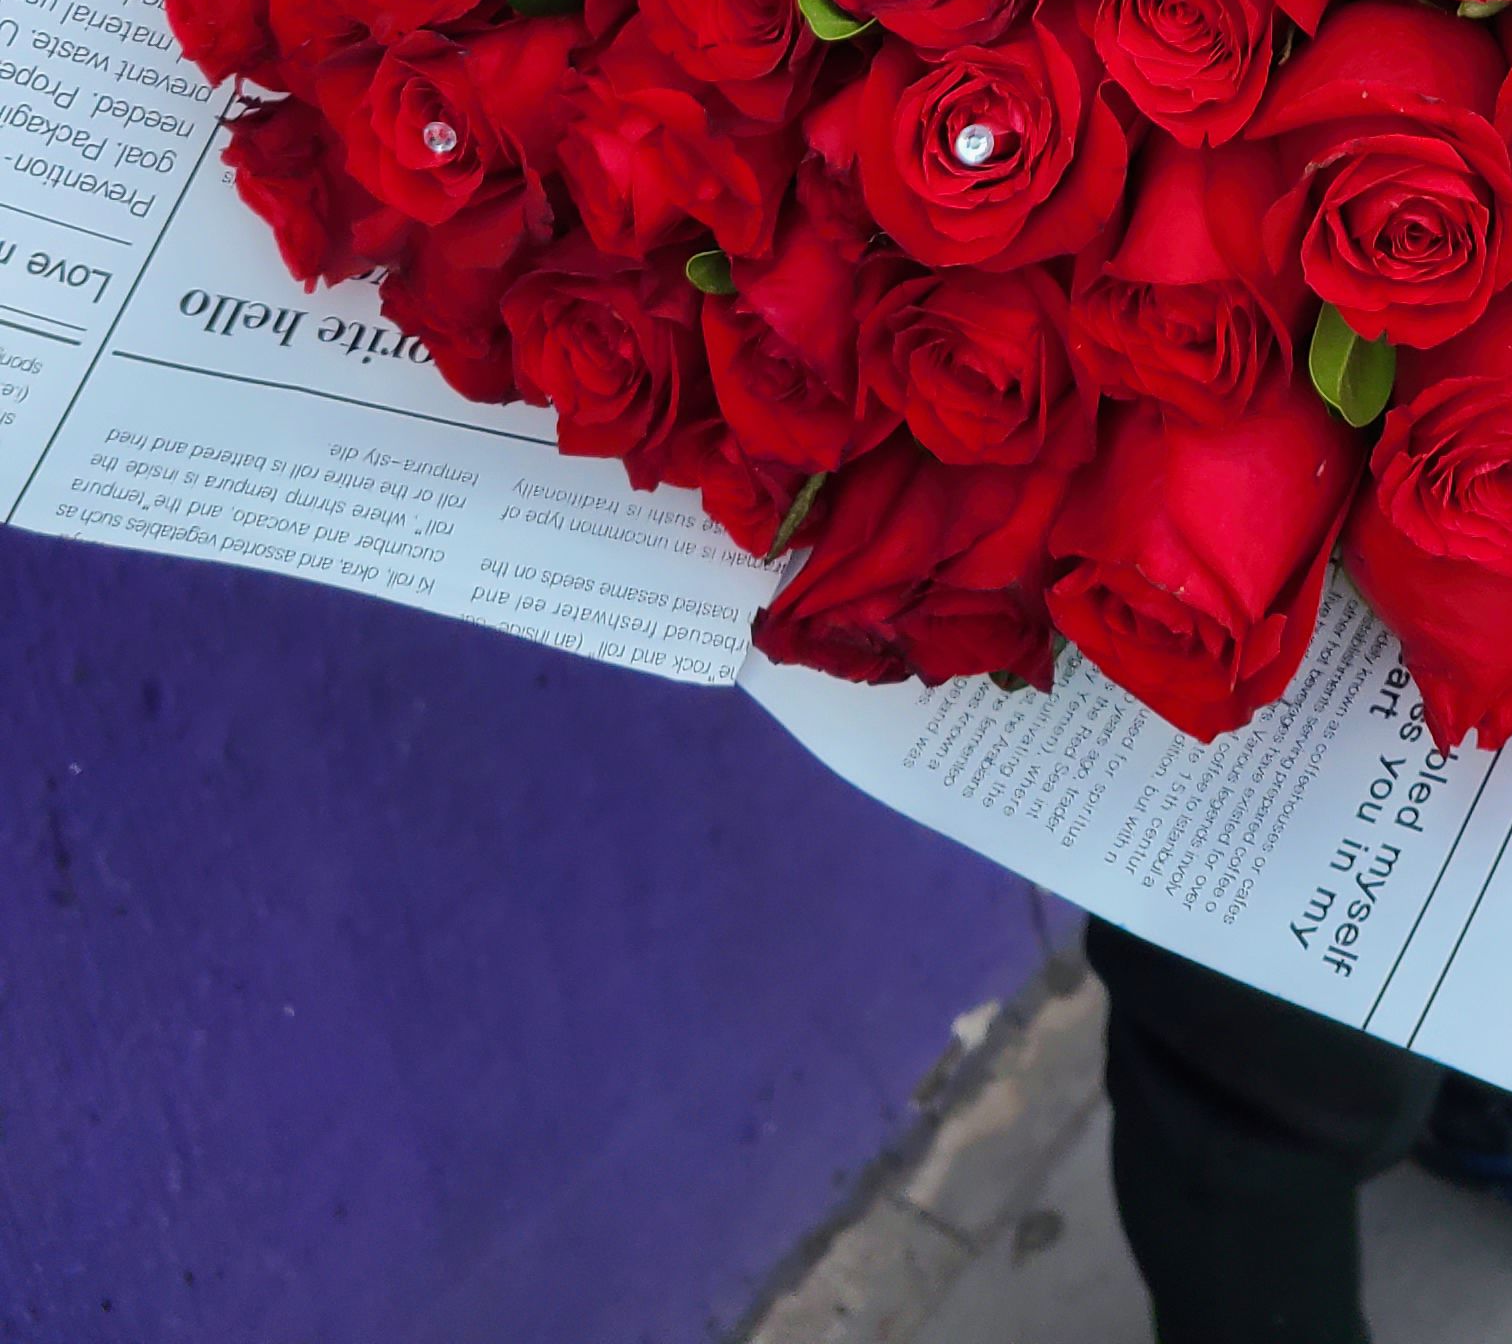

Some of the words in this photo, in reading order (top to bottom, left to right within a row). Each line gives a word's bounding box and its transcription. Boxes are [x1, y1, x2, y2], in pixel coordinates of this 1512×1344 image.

[58, 0, 175, 52] material
[30, 28, 110, 73] waste.
[112, 59, 215, 103] prevent
[89, 91, 195, 139] needed.
[112, 141, 178, 174] goal.
[25, 250, 113, 304] Love
[178, 288, 309, 347] hello
[148, 436, 189, 454] and
[89, 452, 119, 473] the
[124, 458, 180, 481] inside
[187, 443, 268, 473] battered
[269, 458, 288, 473] is
[181, 470, 200, 485] is
[288, 462, 320, 480] roll
[322, 469, 376, 490] entire
[202, 474, 278, 503] tempura
[378, 480, 409, 501] the
[411, 487, 434, 502] or
[54, 502, 79, 519] as
[152, 493, 183, 514] the
[184, 499, 224, 518] and
[283, 487, 347, 516] shrimp
[435, 492, 467, 510] roll
[498, 503, 521, 521] of
[78, 507, 124, 528] such
[230, 505, 311, 536] avocado,
[350, 503, 406, 527] where
[524, 508, 565, 531] type
[123, 516, 217, 547] vegetables
[312, 524, 351, 544] and
[568, 517, 669, 549] uncommon
[217, 535, 297, 563] assorted
[352, 534, 446, 563] cucumber
[672, 538, 697, 556] an
[295, 551, 334, 571] and
[338, 557, 380, 583] okra,
[479, 556, 510, 578] the
[513, 563, 537, 580] on
[385, 567, 416, 588] roll,
[539, 568, 596, 592] seeds
[469, 584, 511, 605] and
[513, 594, 547, 613] eel
[598, 581, 670, 608] sesame
[550, 601, 658, 638] freshwater
[670, 595, 739, 624] toasted
[629, 646, 667, 666] and
[1354, 753, 1407, 824] you
[1112, 815, 1138, 849] with
[1249, 855, 1266, 876] or
[1328, 837, 1370, 873] in
[1181, 873, 1207, 912] over
[1288, 885, 1337, 951] my
[1321, 842, 1402, 978] myself
